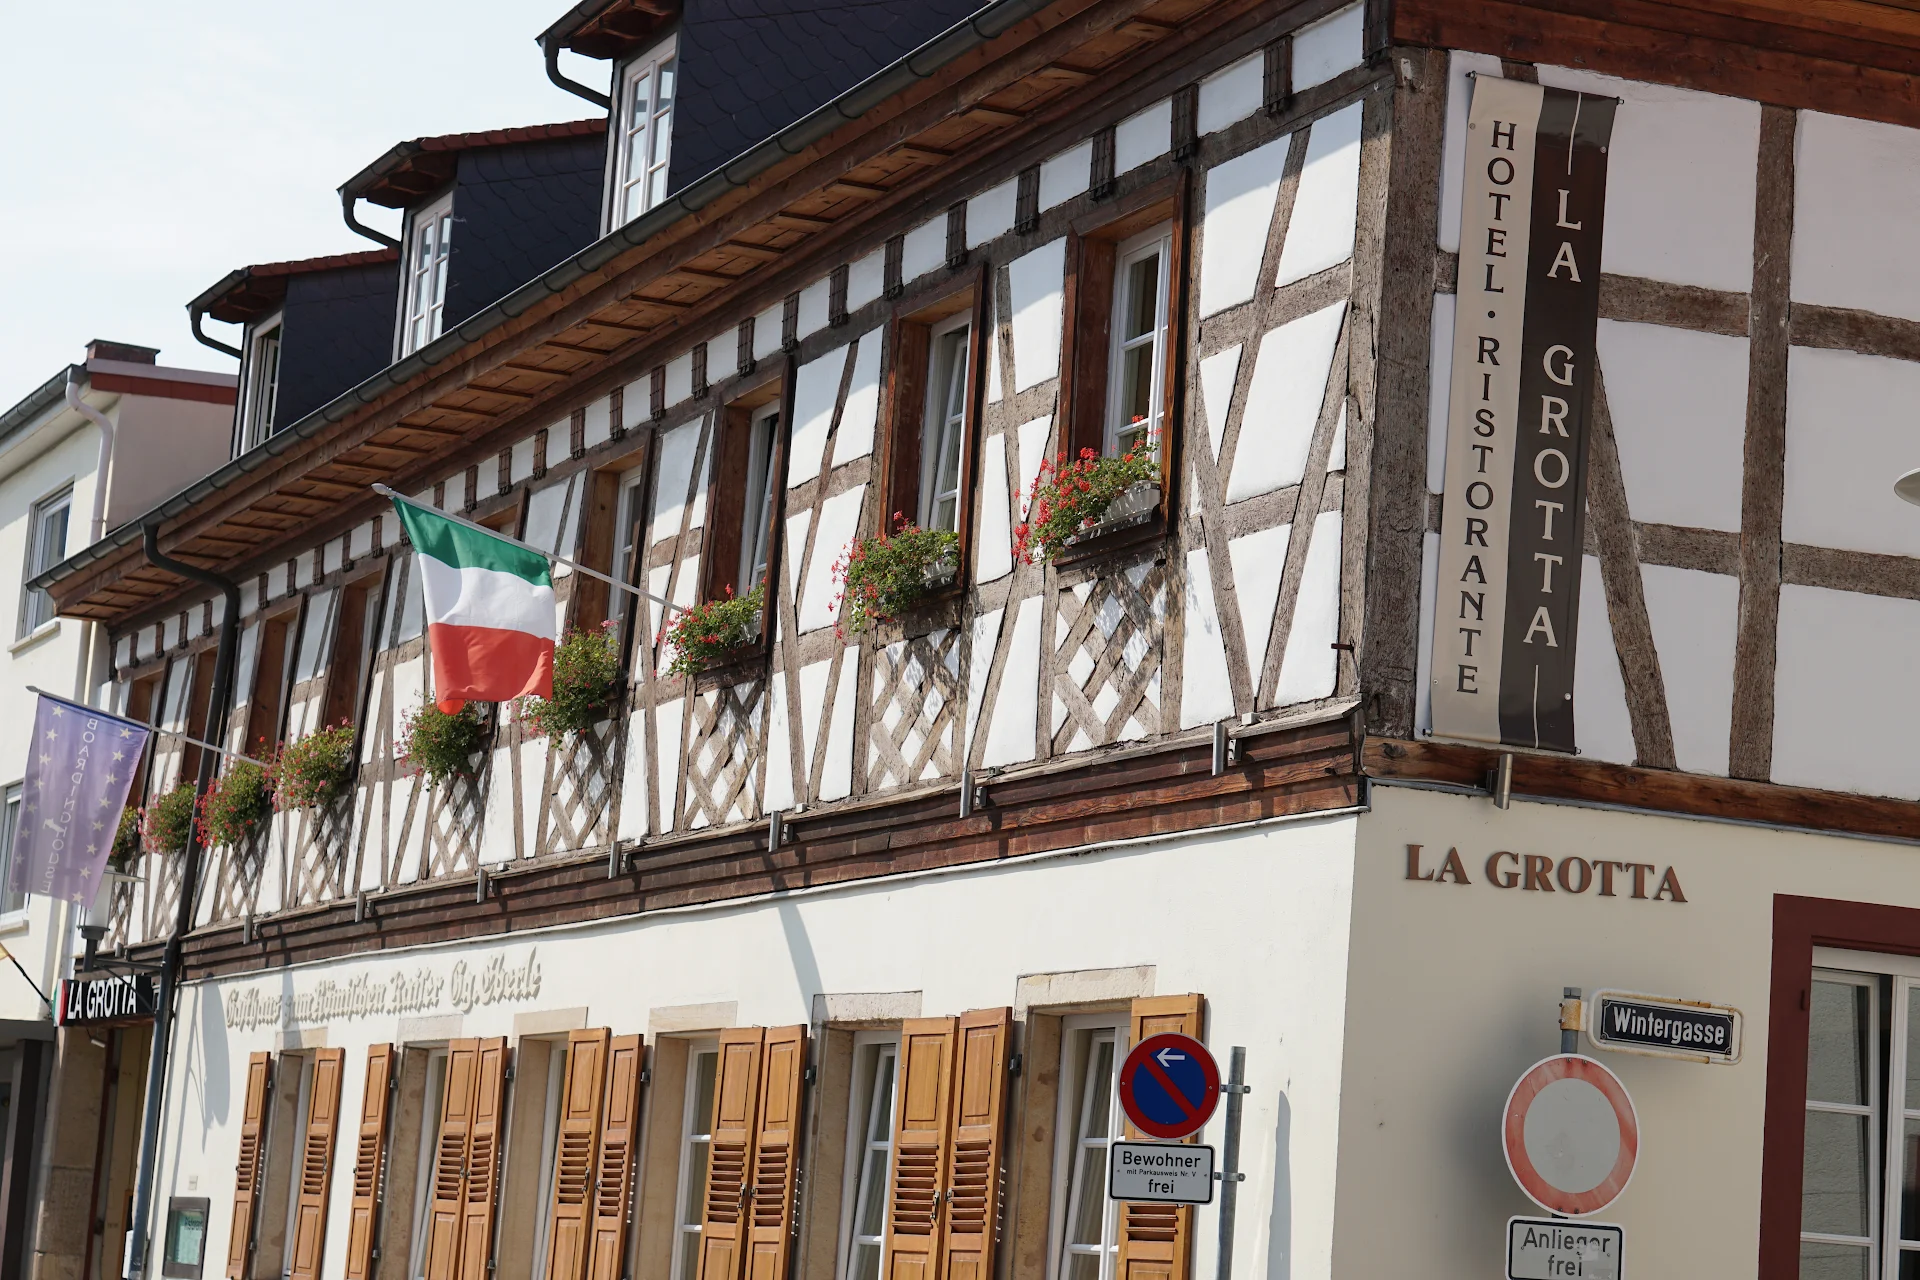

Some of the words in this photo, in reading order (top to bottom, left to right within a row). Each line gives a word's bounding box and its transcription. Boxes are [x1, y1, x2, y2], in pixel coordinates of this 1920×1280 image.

[1484, 120, 1517, 293] HOTEL
[1547, 188, 1582, 283] LA
[1456, 336, 1500, 694] RISTORANTE
[1523, 344, 1575, 648] GROTTA
[1405, 843, 1472, 885] LA
[1485, 851, 1689, 903] GROTTA
[67, 981, 83, 1020] LA
[86, 974, 137, 1020] GROTTA
[1613, 1006, 1725, 1045] Wintergasse
[1122, 1151, 1201, 1167] Bewohner
[1148, 1179, 1174, 1193] frei
[1547, 1254, 1582, 1277] frei
